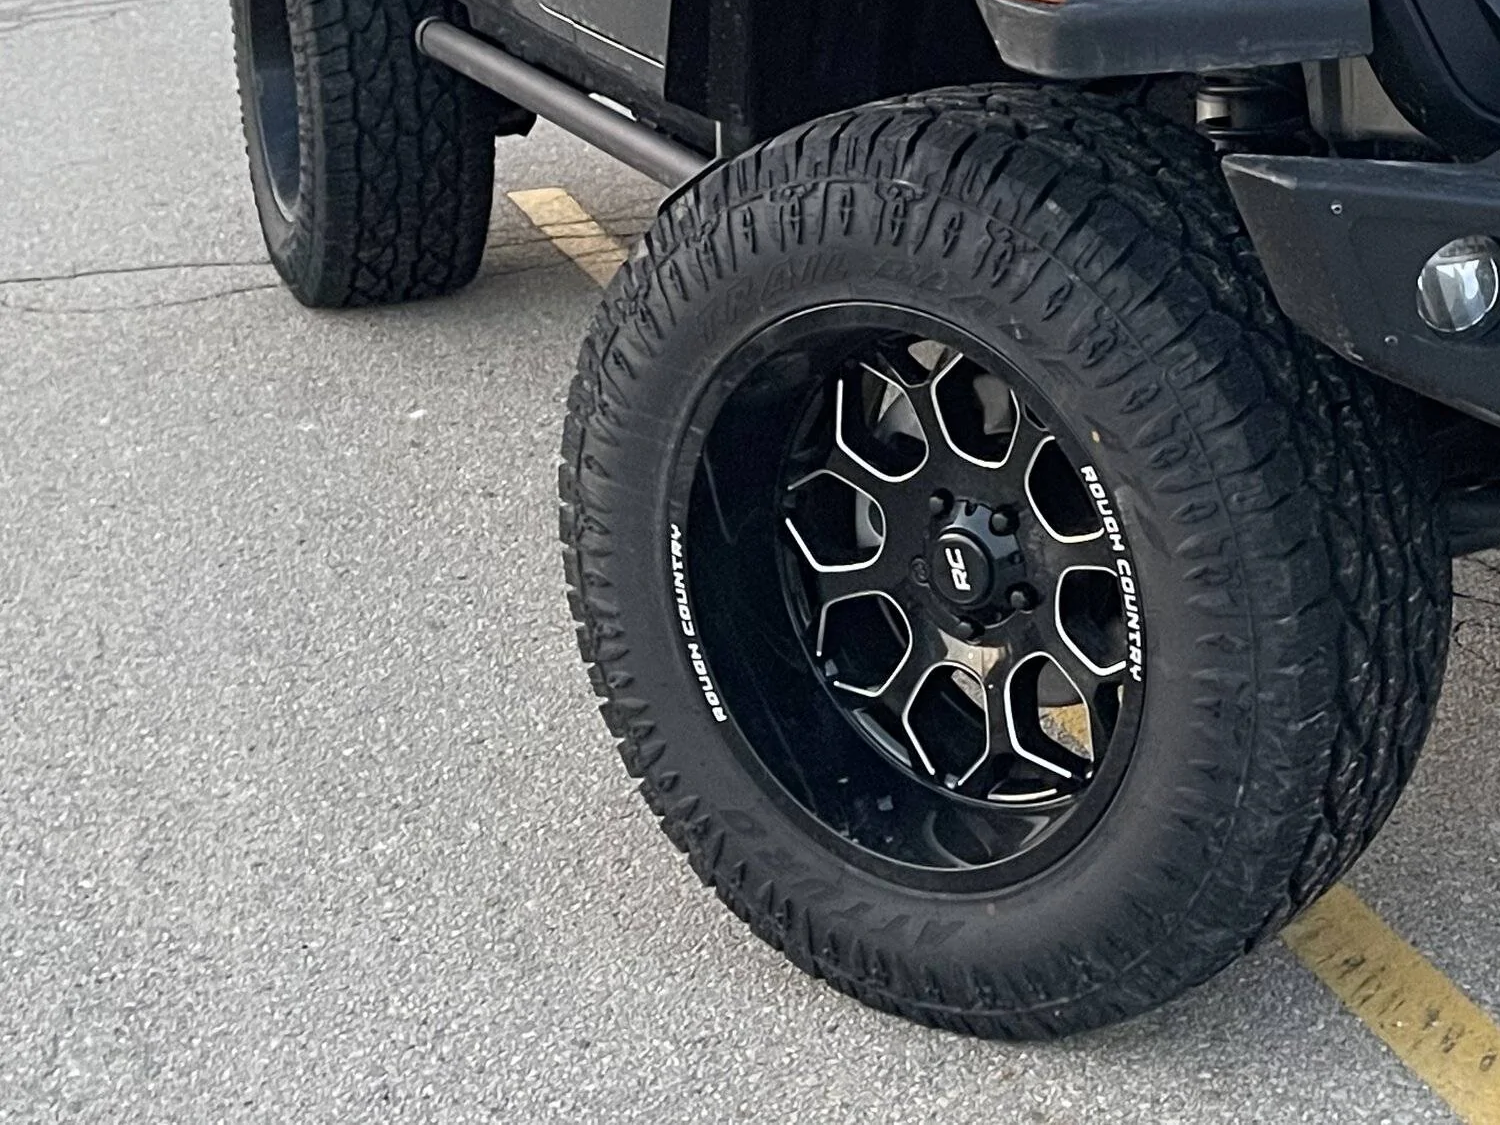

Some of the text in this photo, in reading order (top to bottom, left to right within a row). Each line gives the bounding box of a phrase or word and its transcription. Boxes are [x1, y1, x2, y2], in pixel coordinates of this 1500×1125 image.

[670, 523, 728, 722] ROUGH COUNTRY
[945, 547, 971, 591] RC
[1080, 465, 1143, 682] ROUGH COUNTRY
